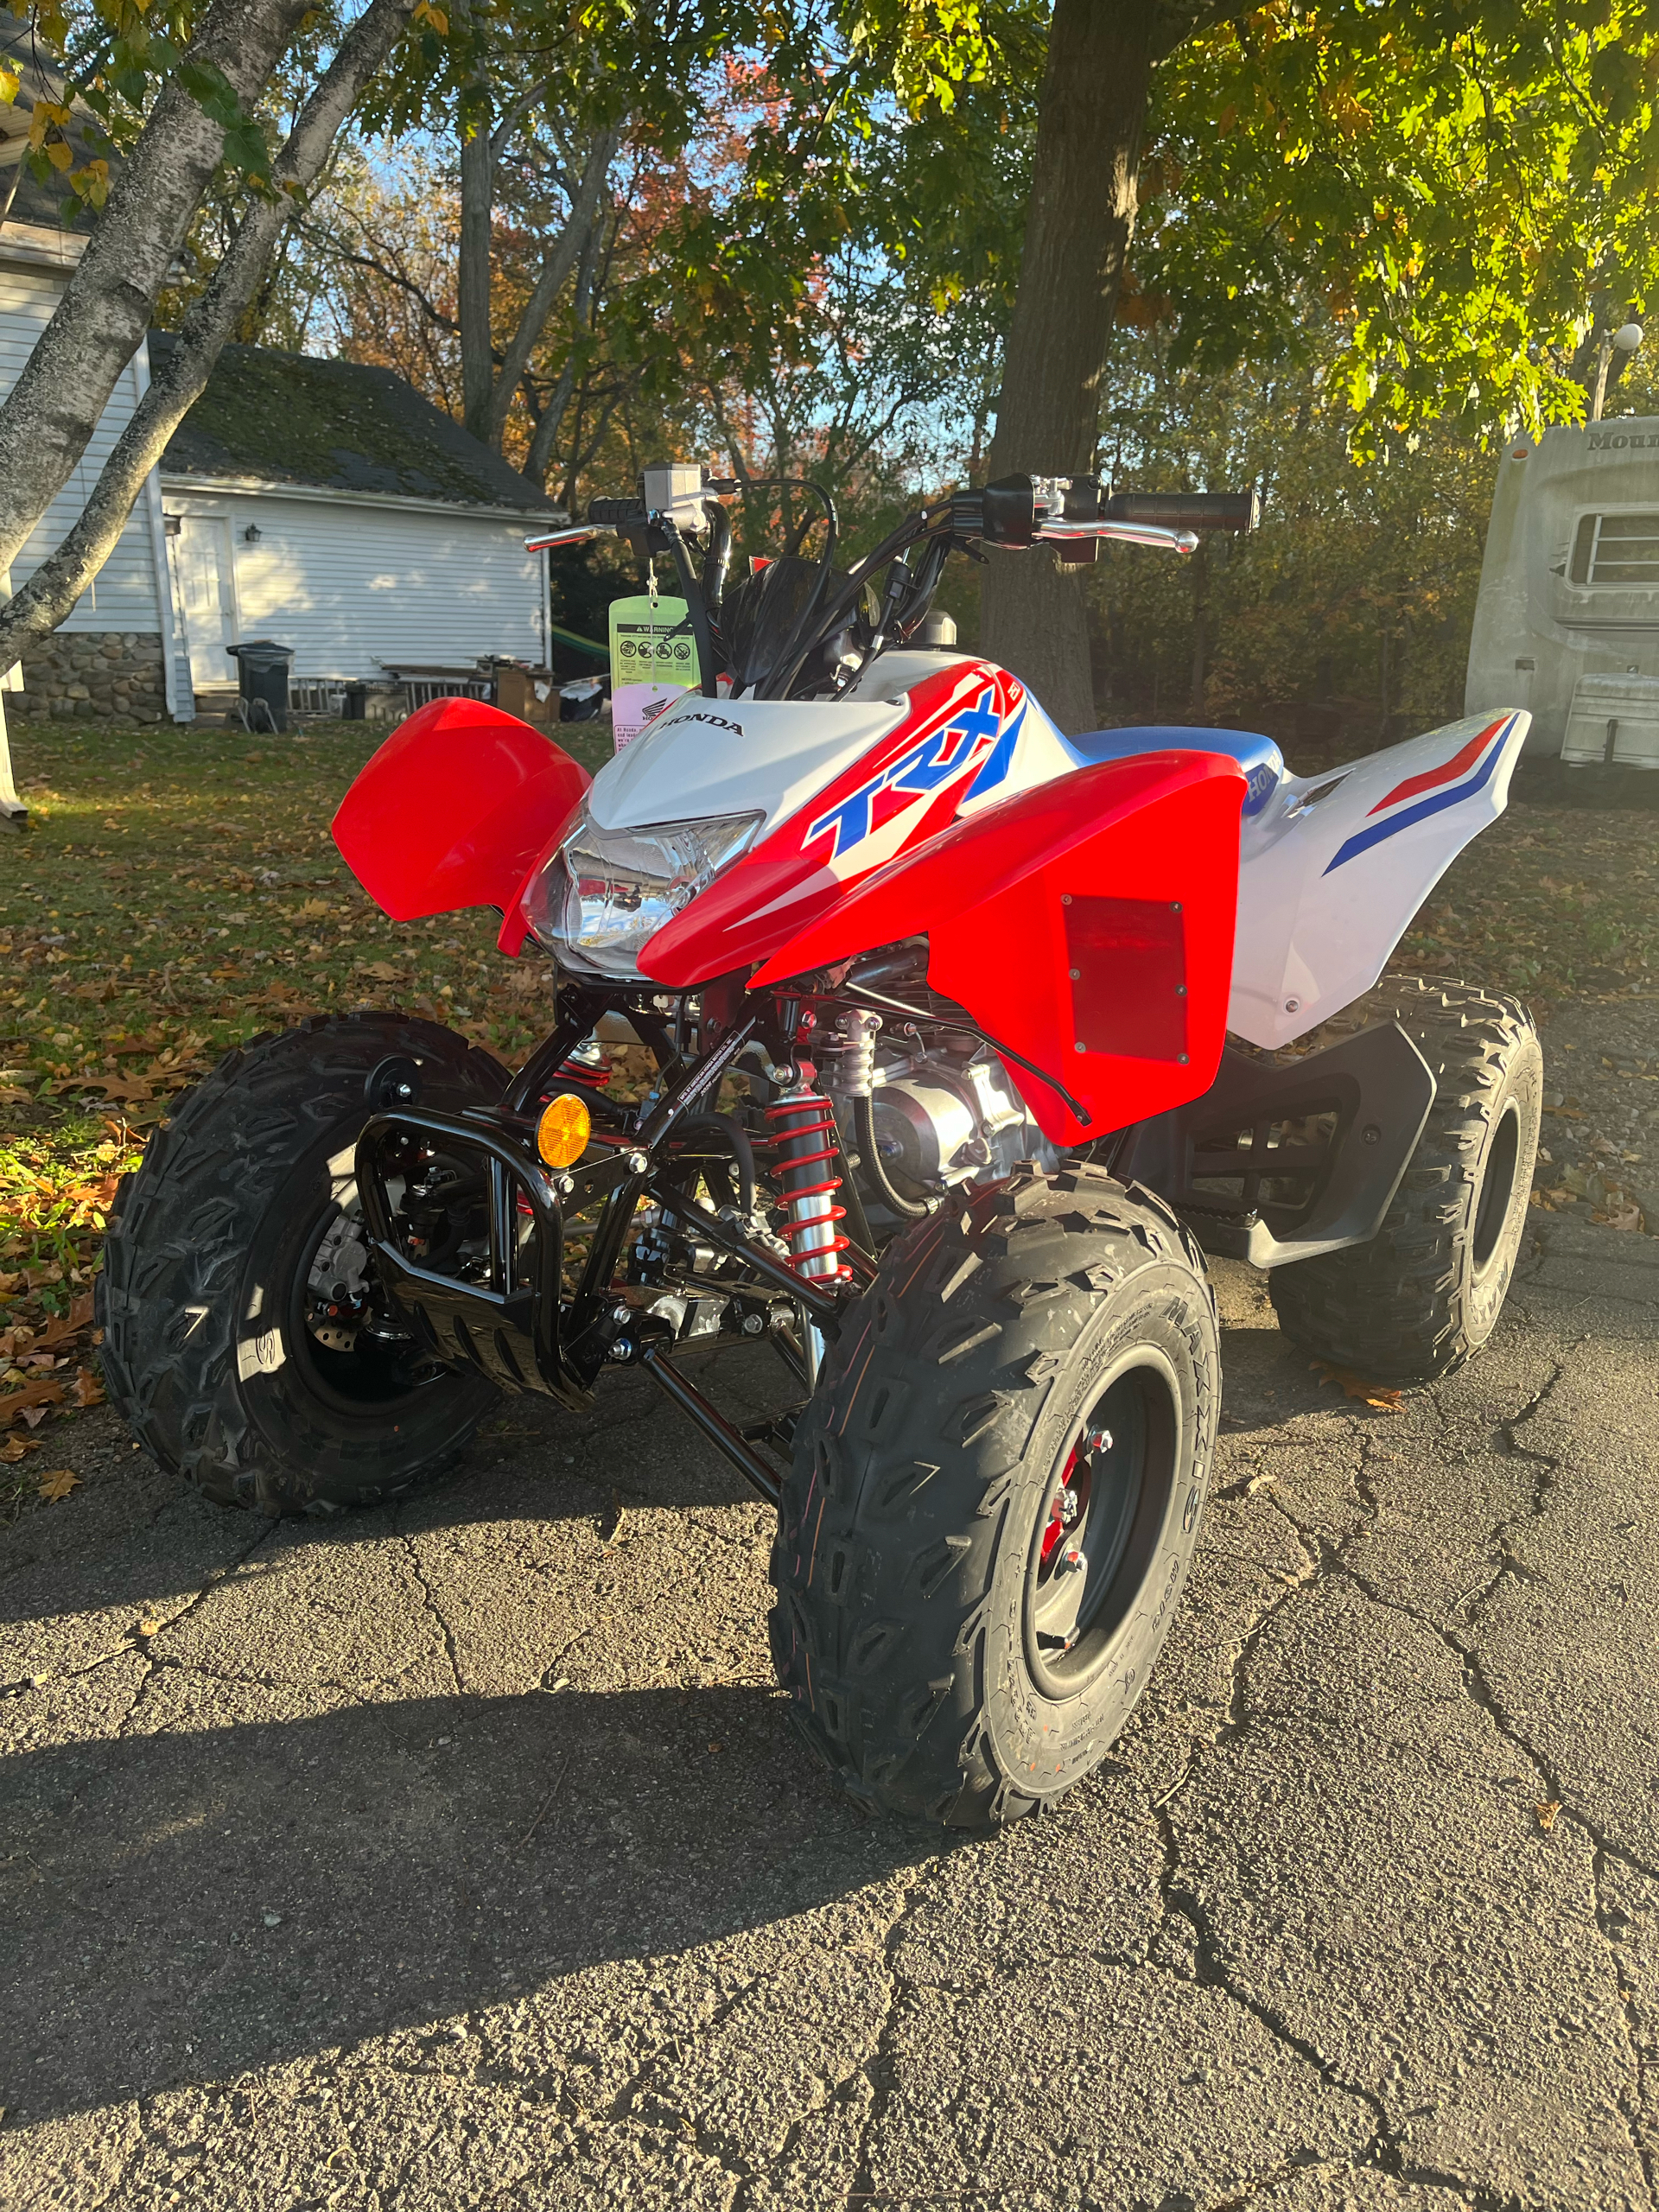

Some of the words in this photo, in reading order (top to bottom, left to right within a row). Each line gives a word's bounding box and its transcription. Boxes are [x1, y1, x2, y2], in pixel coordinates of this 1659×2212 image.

[658, 713, 744, 737] HONDA
[802, 683, 1001, 861] TRX
[702, 1059, 714, 1072] HONDA
[1159, 1295, 1211, 1534] MAXXIS
